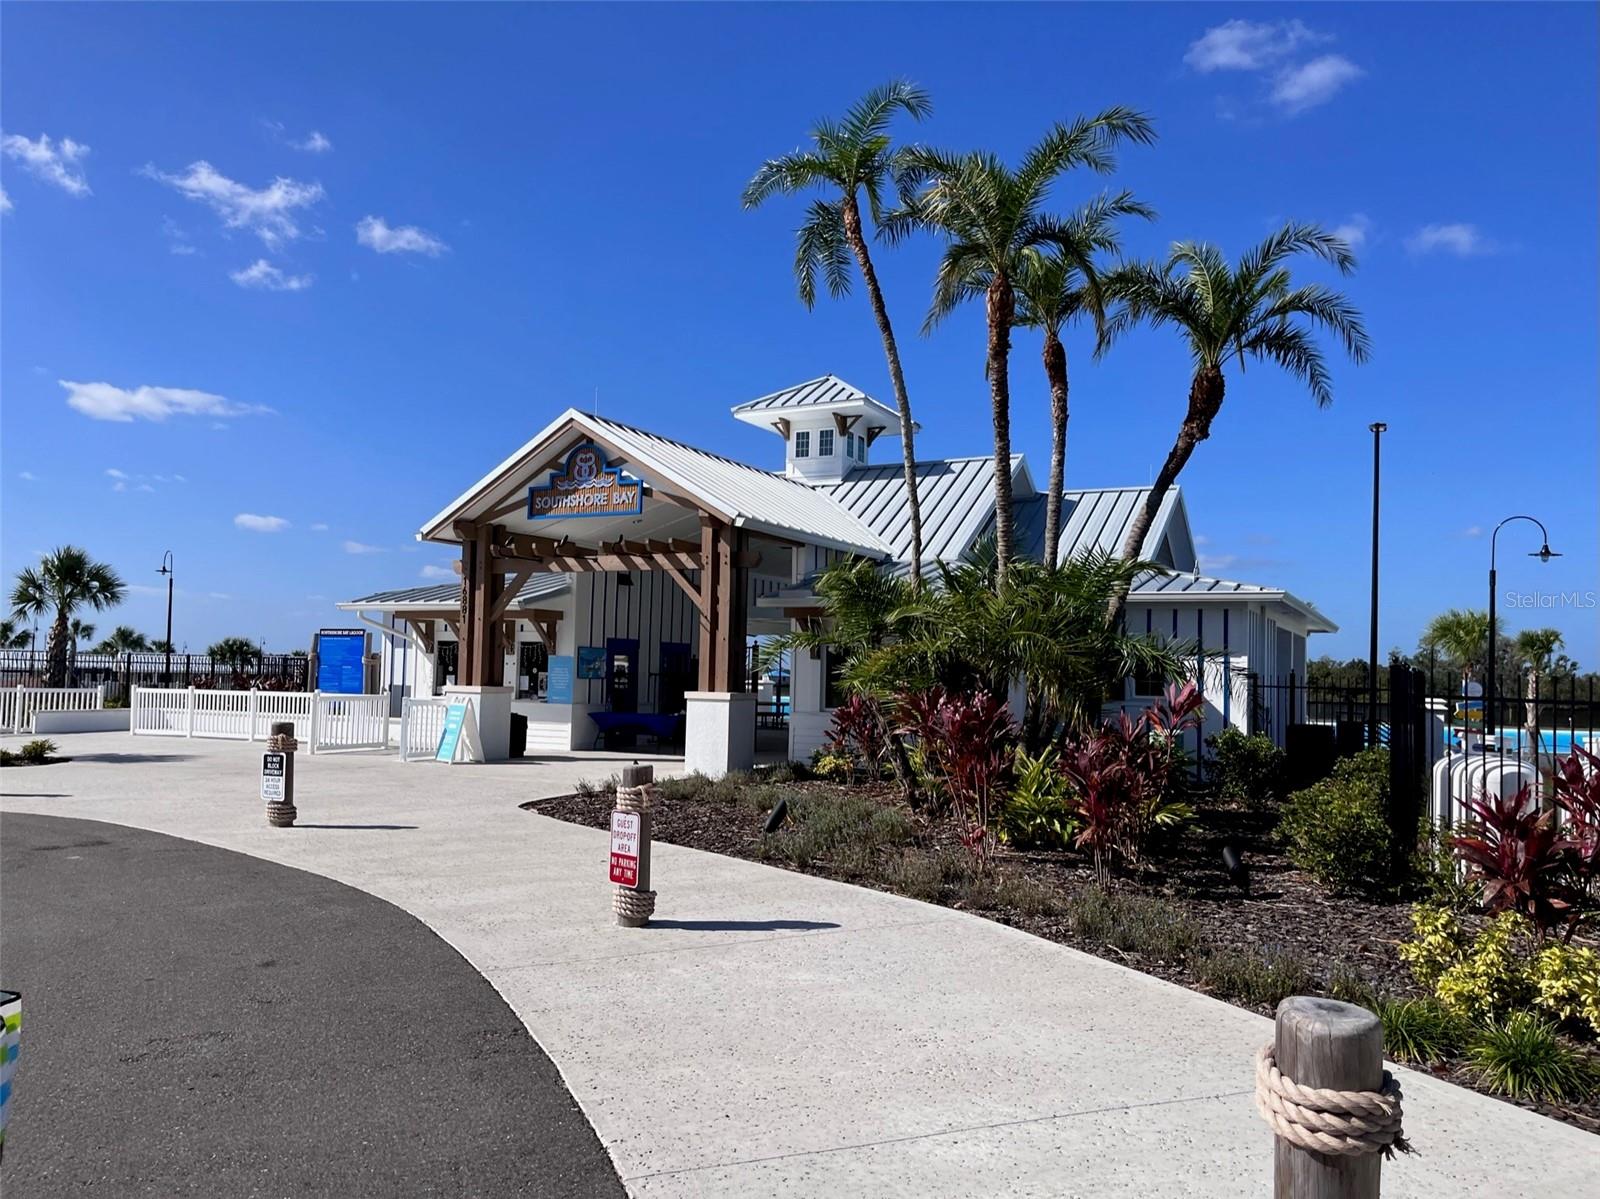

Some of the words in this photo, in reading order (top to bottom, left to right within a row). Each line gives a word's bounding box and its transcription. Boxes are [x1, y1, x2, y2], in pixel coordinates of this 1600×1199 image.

[535, 494, 608, 509] SOUTHSHORE
[613, 492, 635, 504] BAY
[617, 819, 633, 829] GUEST
[617, 843, 631, 853] AREA
[611, 856, 618, 865] NO
[618, 857, 637, 870] PARKING
[613, 867, 622, 876] ANY
[623, 868, 634, 879] TIME
